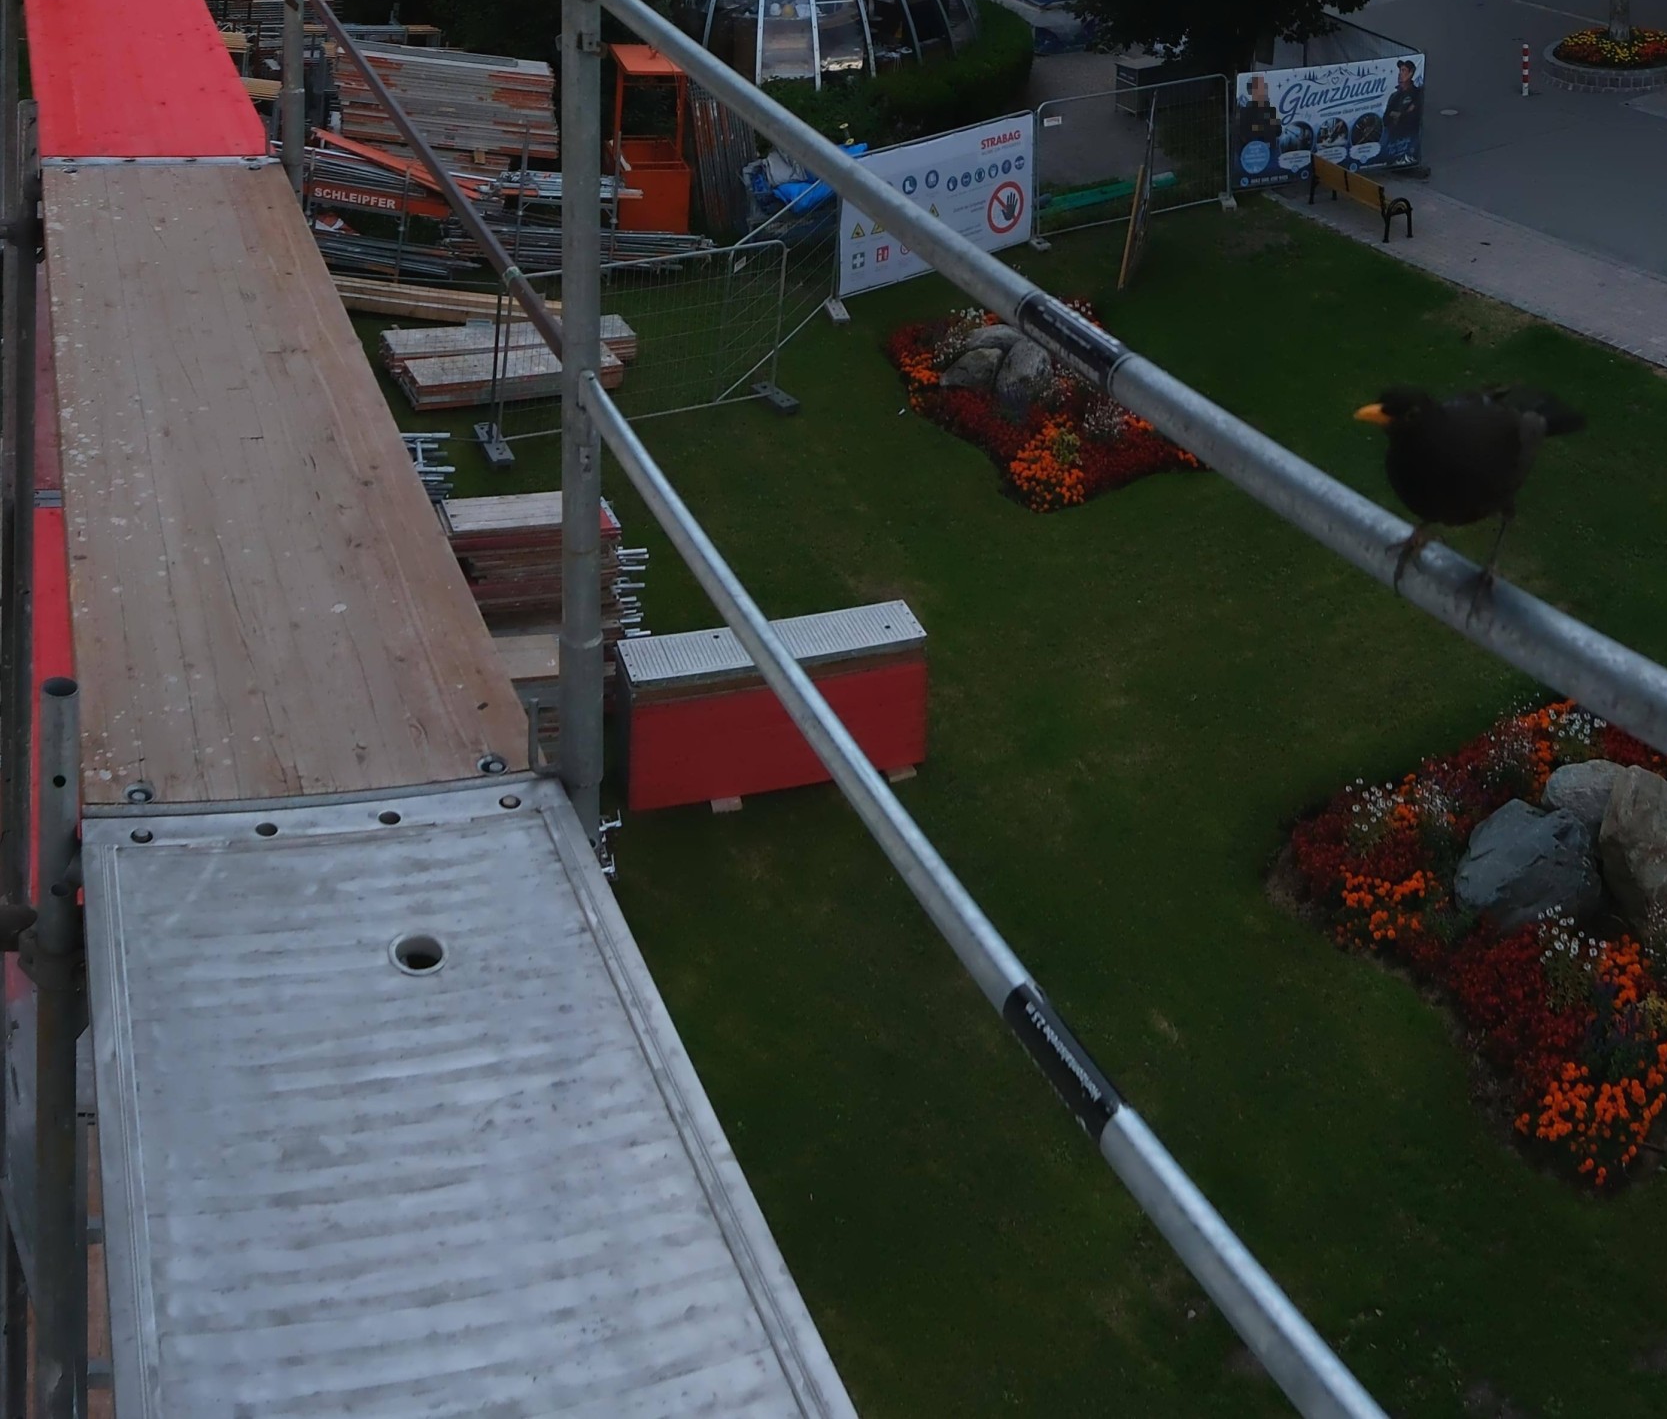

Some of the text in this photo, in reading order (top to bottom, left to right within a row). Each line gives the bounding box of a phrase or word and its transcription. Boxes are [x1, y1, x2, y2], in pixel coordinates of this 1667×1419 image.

[1279, 75, 1388, 125] Glanzbuam
[981, 130, 1021, 150] STRABAG
[313, 187, 397, 210] SCHLEIPFER
